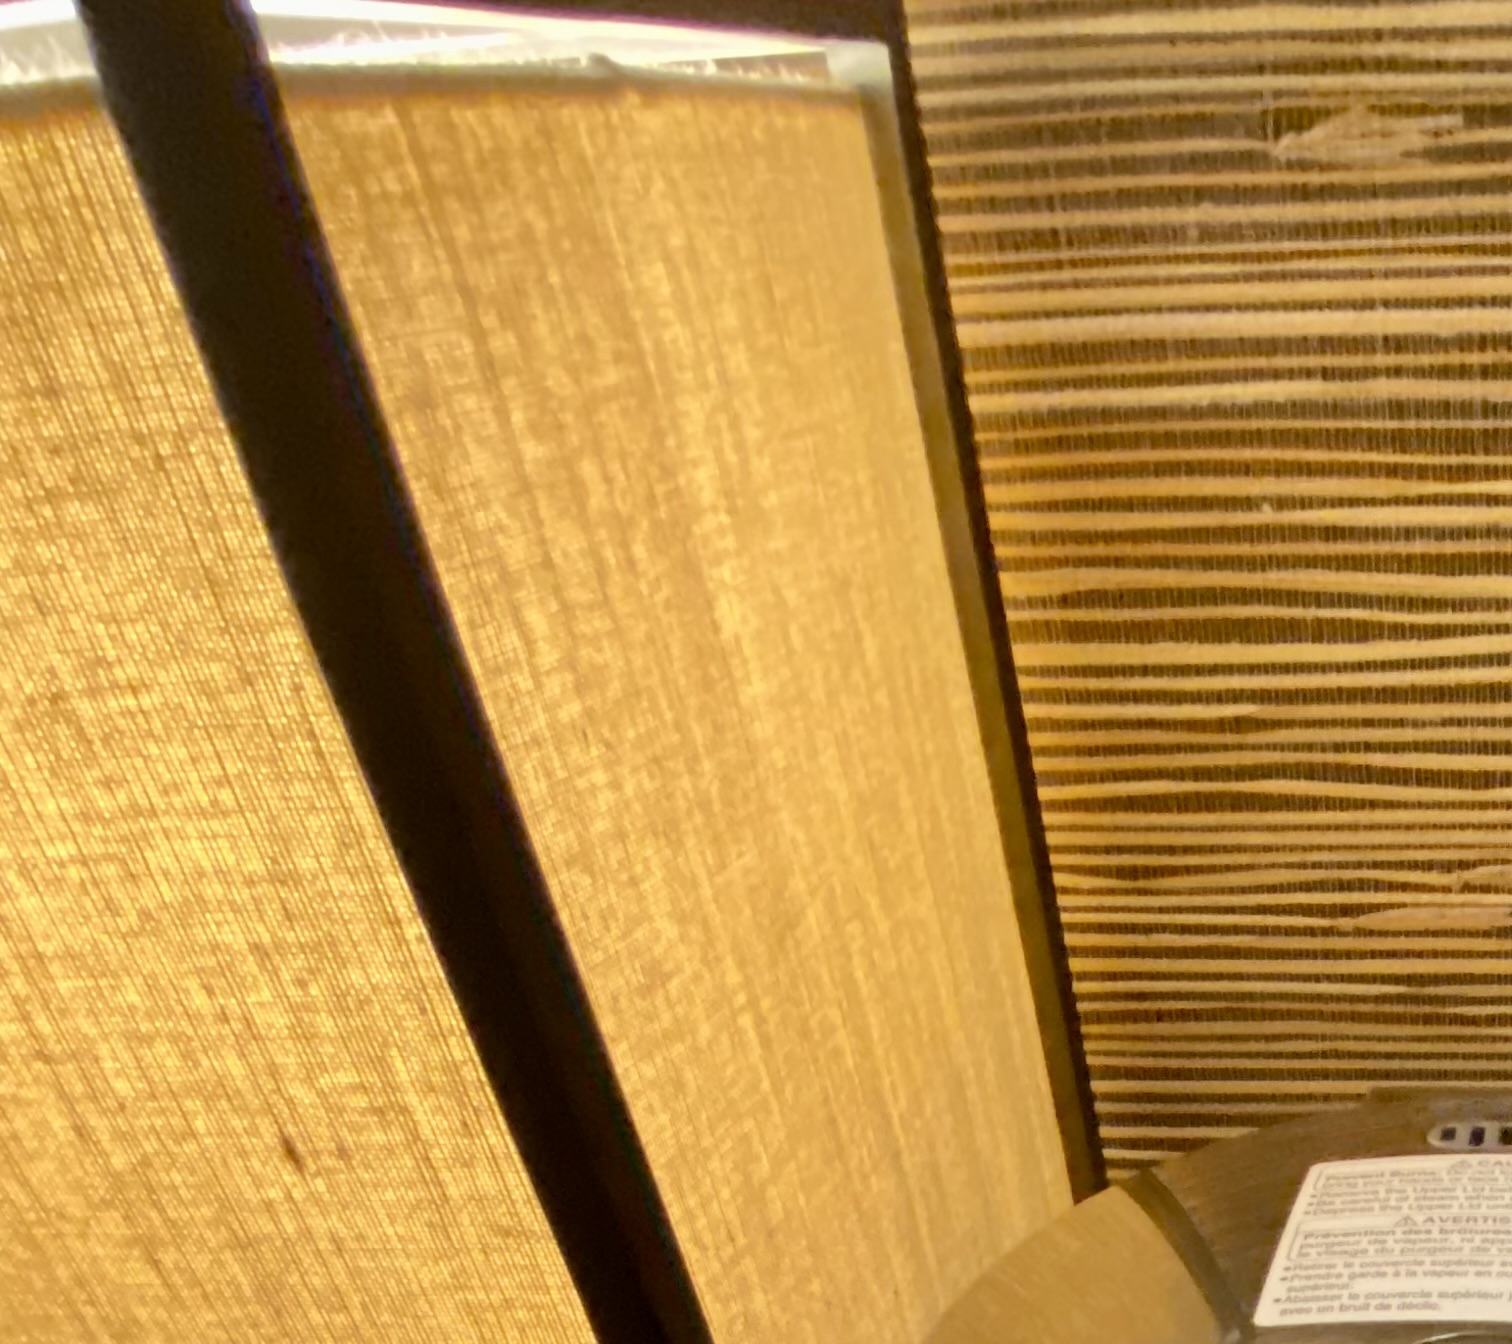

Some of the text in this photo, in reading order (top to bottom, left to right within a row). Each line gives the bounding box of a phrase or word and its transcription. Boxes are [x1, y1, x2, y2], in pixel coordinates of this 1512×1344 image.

[1280, 1306, 1312, 1316] avec
[1317, 1305, 1334, 1313] un
[1339, 1303, 1370, 1311] bruit
